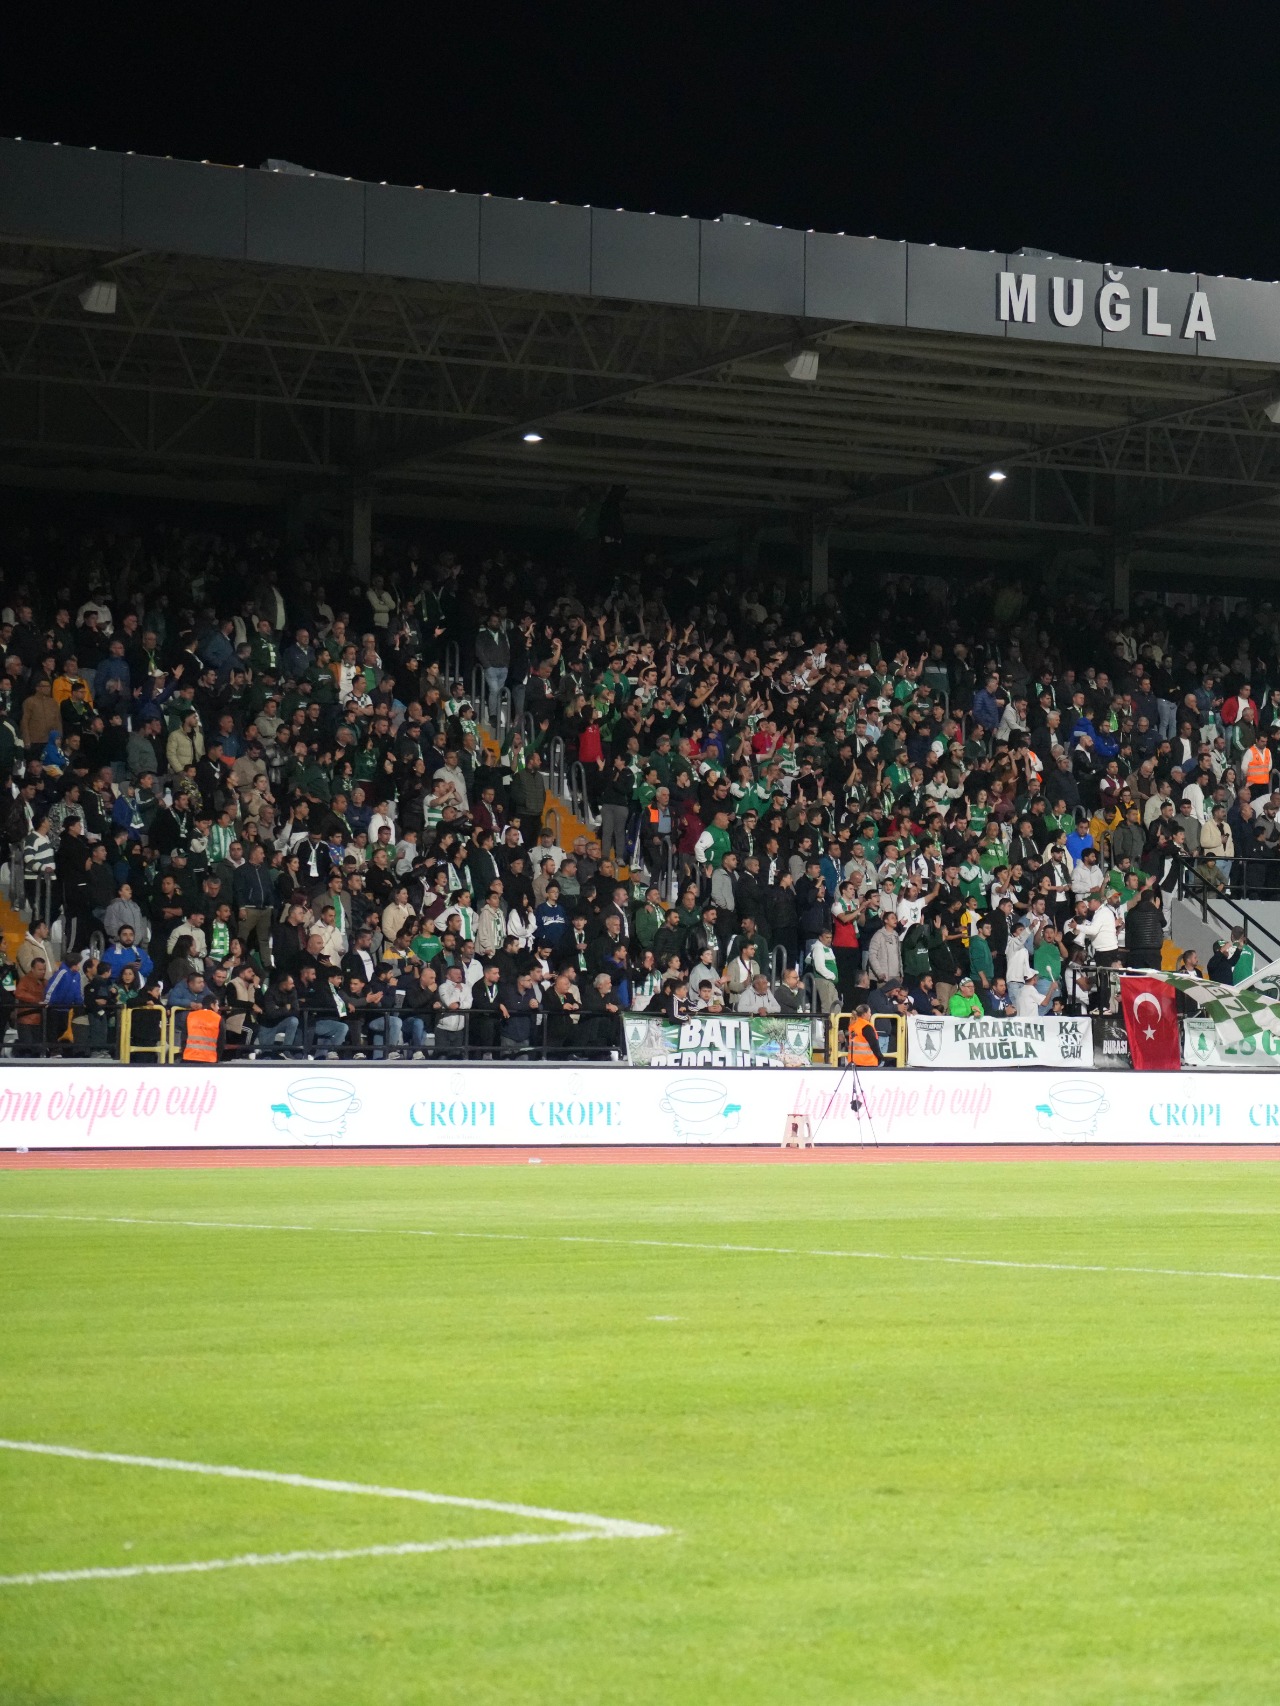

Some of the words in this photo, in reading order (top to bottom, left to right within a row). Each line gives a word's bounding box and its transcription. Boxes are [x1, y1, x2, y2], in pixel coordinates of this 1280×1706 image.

[998, 270, 1216, 341] MUĞLA
[679, 1018, 750, 1050] BATI
[954, 1021, 1046, 1042] KARARGAH
[968, 1038, 1038, 1060] MUĞLA
[1102, 1039, 1128, 1055] BURASI
[48, 1082, 128, 1136] crope
[132, 1081, 160, 1117] to
[166, 1080, 218, 1131] cup
[529, 1101, 621, 1127] CROPE
[923, 1084, 946, 1117] to
[949, 1082, 992, 1130] cup
